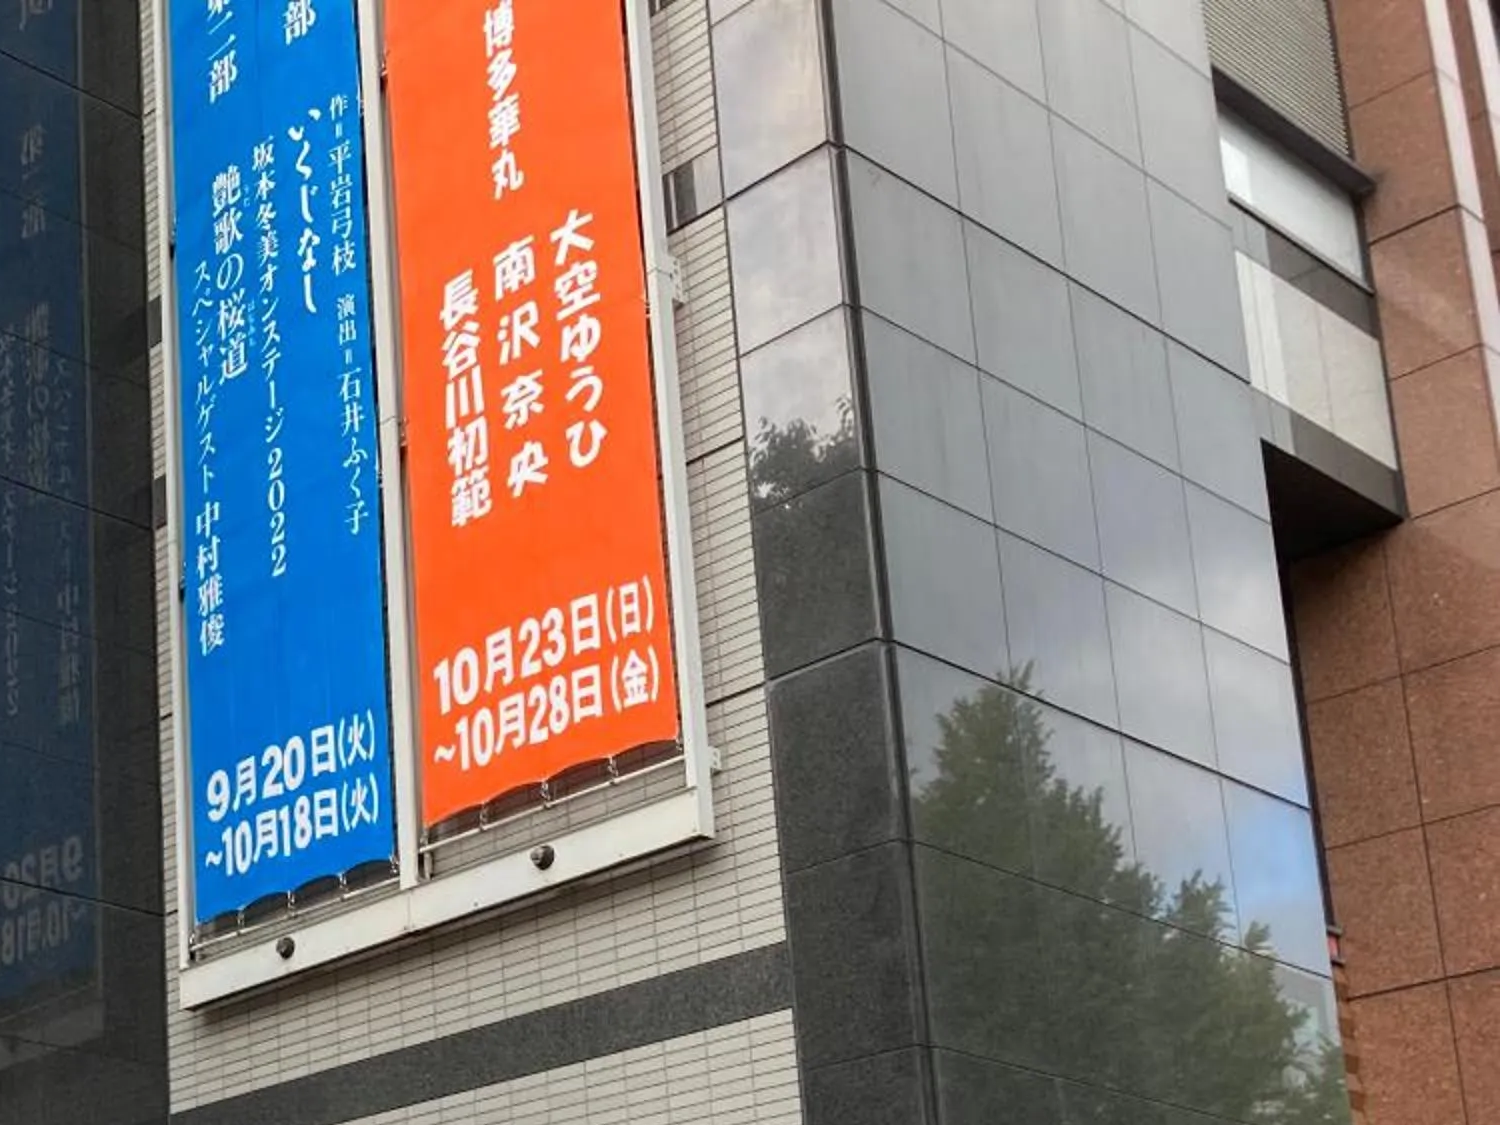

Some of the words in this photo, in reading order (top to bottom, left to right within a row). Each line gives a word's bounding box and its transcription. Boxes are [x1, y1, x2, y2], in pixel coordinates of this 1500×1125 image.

[287, 108, 322, 314] いくじなし
[483, 0, 525, 201] 博多華丸
[192, 260, 216, 495] スペシャルゲスト
[439, 268, 492, 526] 長谷川初範
[493, 234, 549, 497] 南沢奈央
[550, 208, 607, 469] 大空ゆうひ
[195, 501, 225, 656] 中村雅俊
